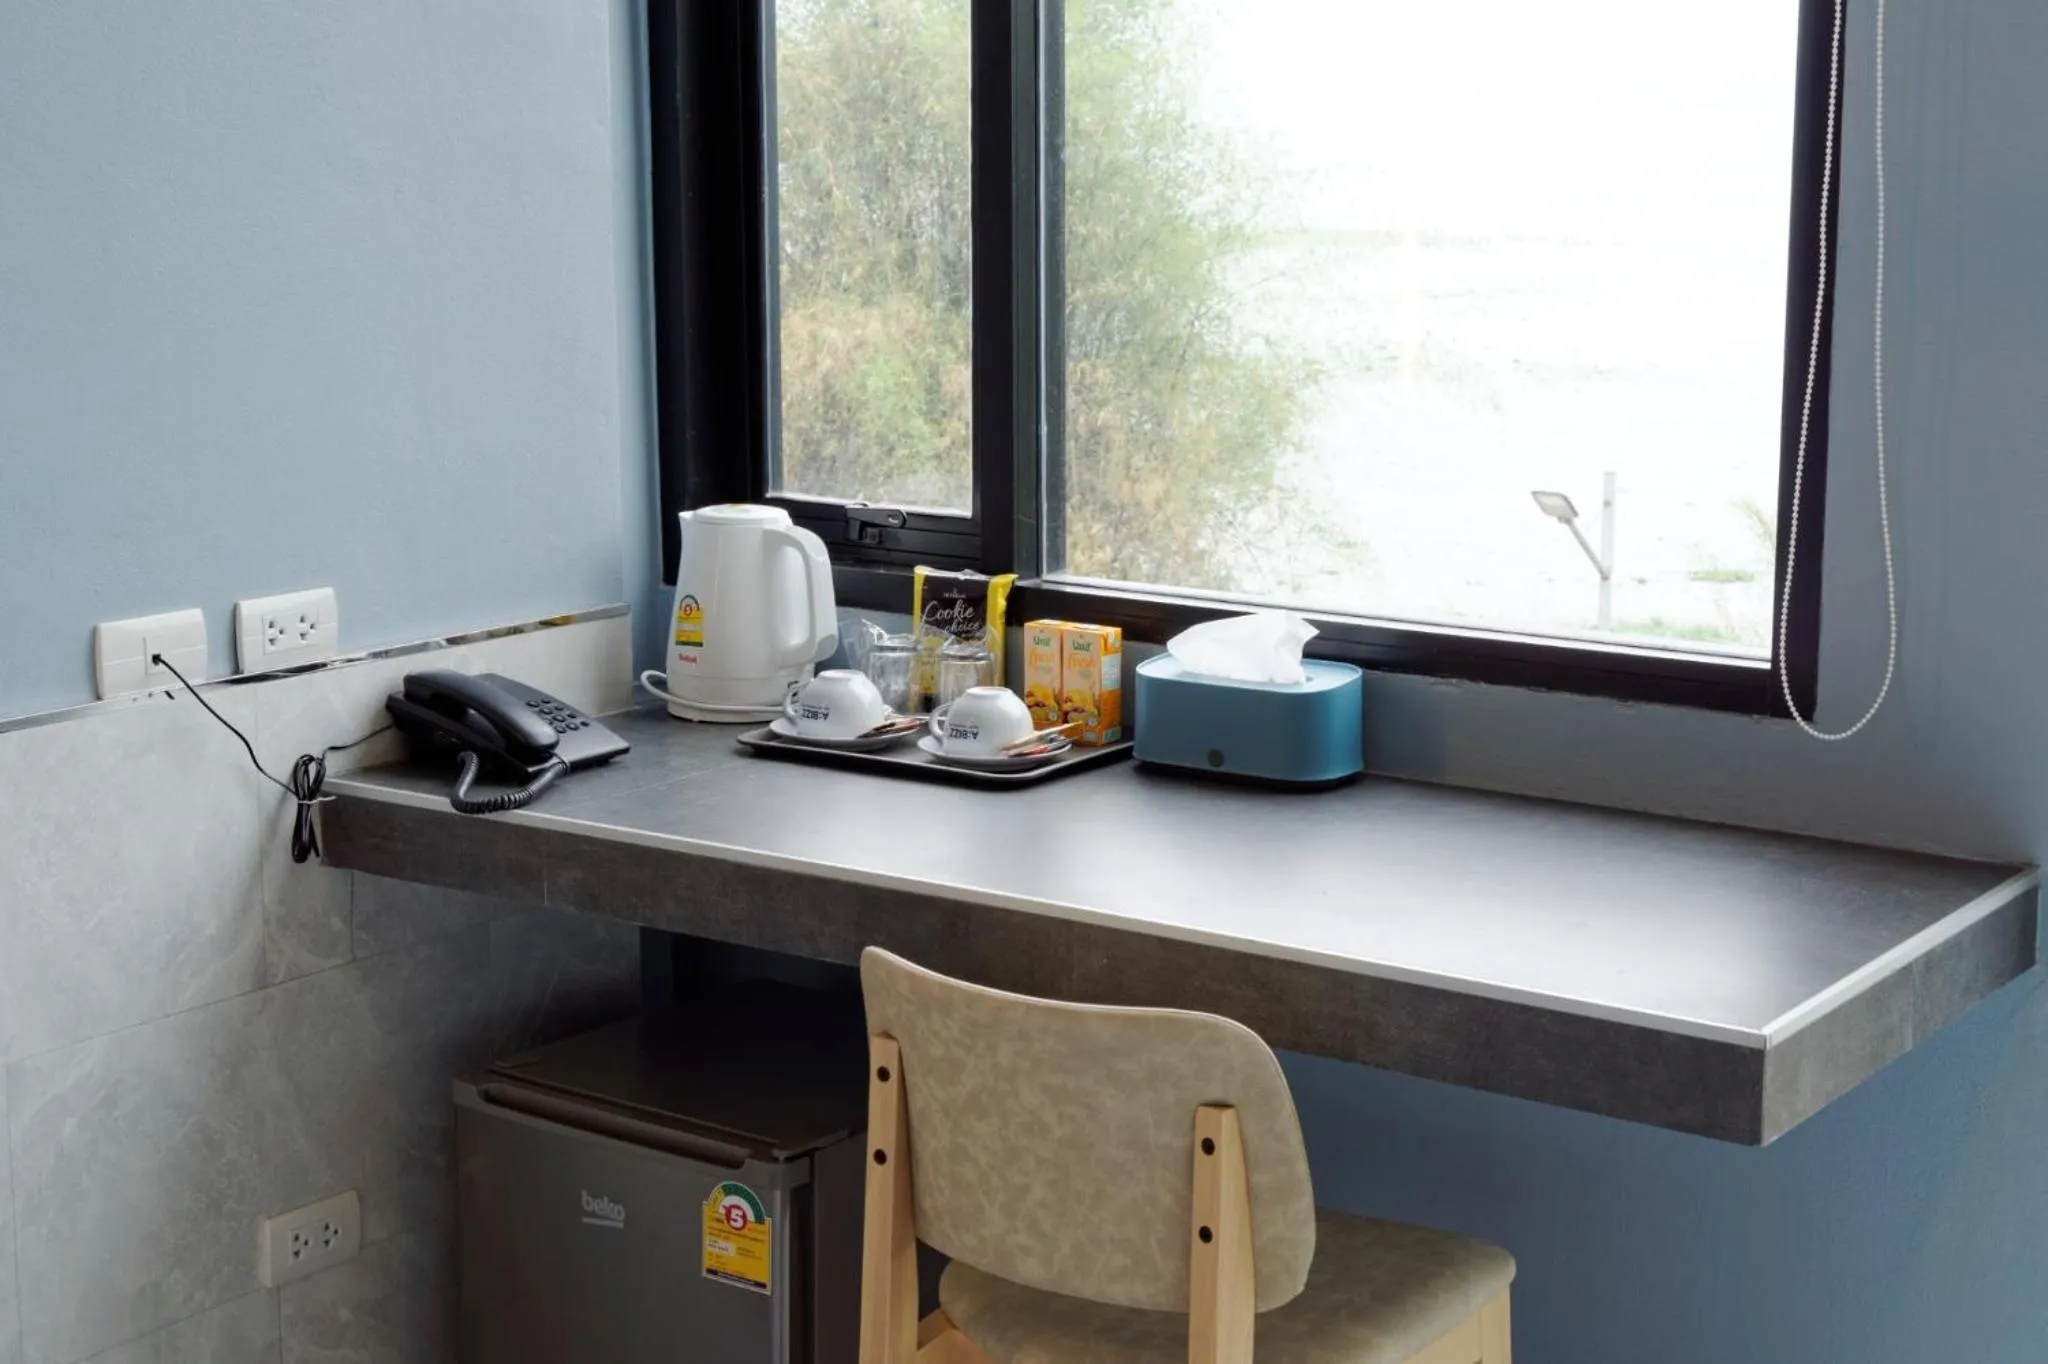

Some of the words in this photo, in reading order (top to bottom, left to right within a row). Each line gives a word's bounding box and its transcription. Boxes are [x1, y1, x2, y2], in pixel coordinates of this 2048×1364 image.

[923, 600, 975, 621] Cookie
[1072, 640, 1092, 652] Unif
[582, 1190, 625, 1221] beko
[729, 1206, 744, 1229] 5
